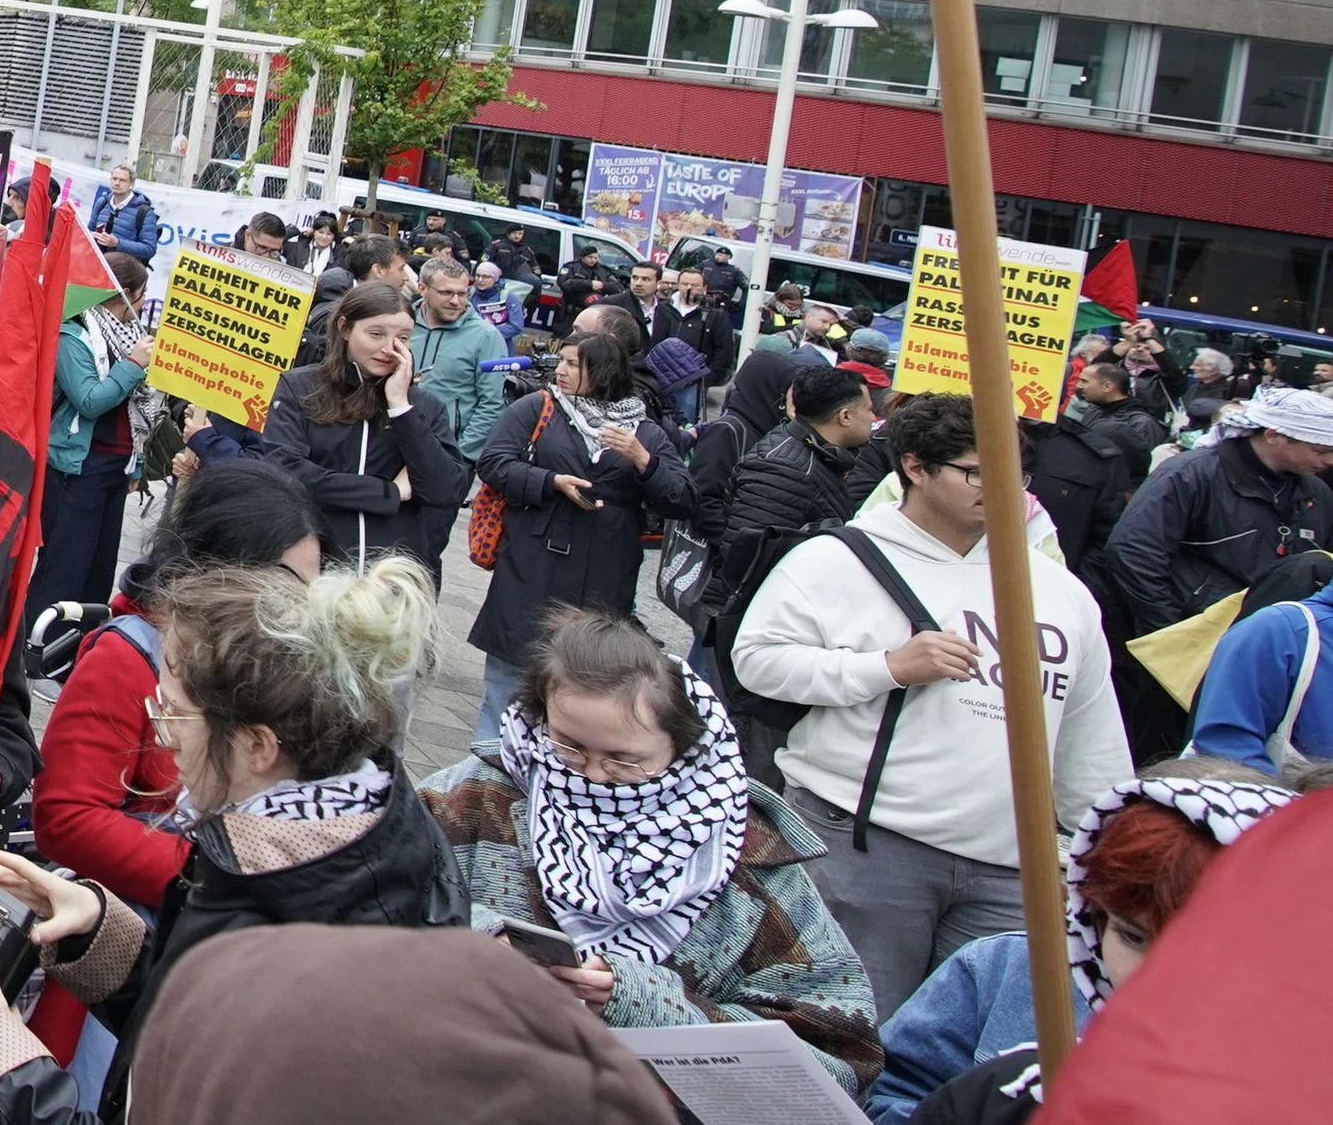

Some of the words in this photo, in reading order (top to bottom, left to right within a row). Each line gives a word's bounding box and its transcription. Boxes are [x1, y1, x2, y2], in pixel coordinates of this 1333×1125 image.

[606, 175, 638, 186] 16:00
[636, 166, 650, 174] AB
[663, 162, 709, 181] TASTE
[717, 168, 741, 184] OF
[177, 256, 260, 294] FREIHEIT
[263, 287, 302, 311] FÜR
[1026, 268, 1071, 290] FÜR
[172, 274, 289, 326] PALÄSTINA!
[169, 297, 271, 344] RASSISMUS
[158, 338, 265, 390] Islamophobie
[154, 356, 243, 399] bekämpfen
[959, 698, 988, 708] COLOR
[972, 709, 988, 718] THE
[652, 1057, 674, 1066] Wer
[675, 1057, 691, 1066] ist
[693, 1057, 710, 1066] die
